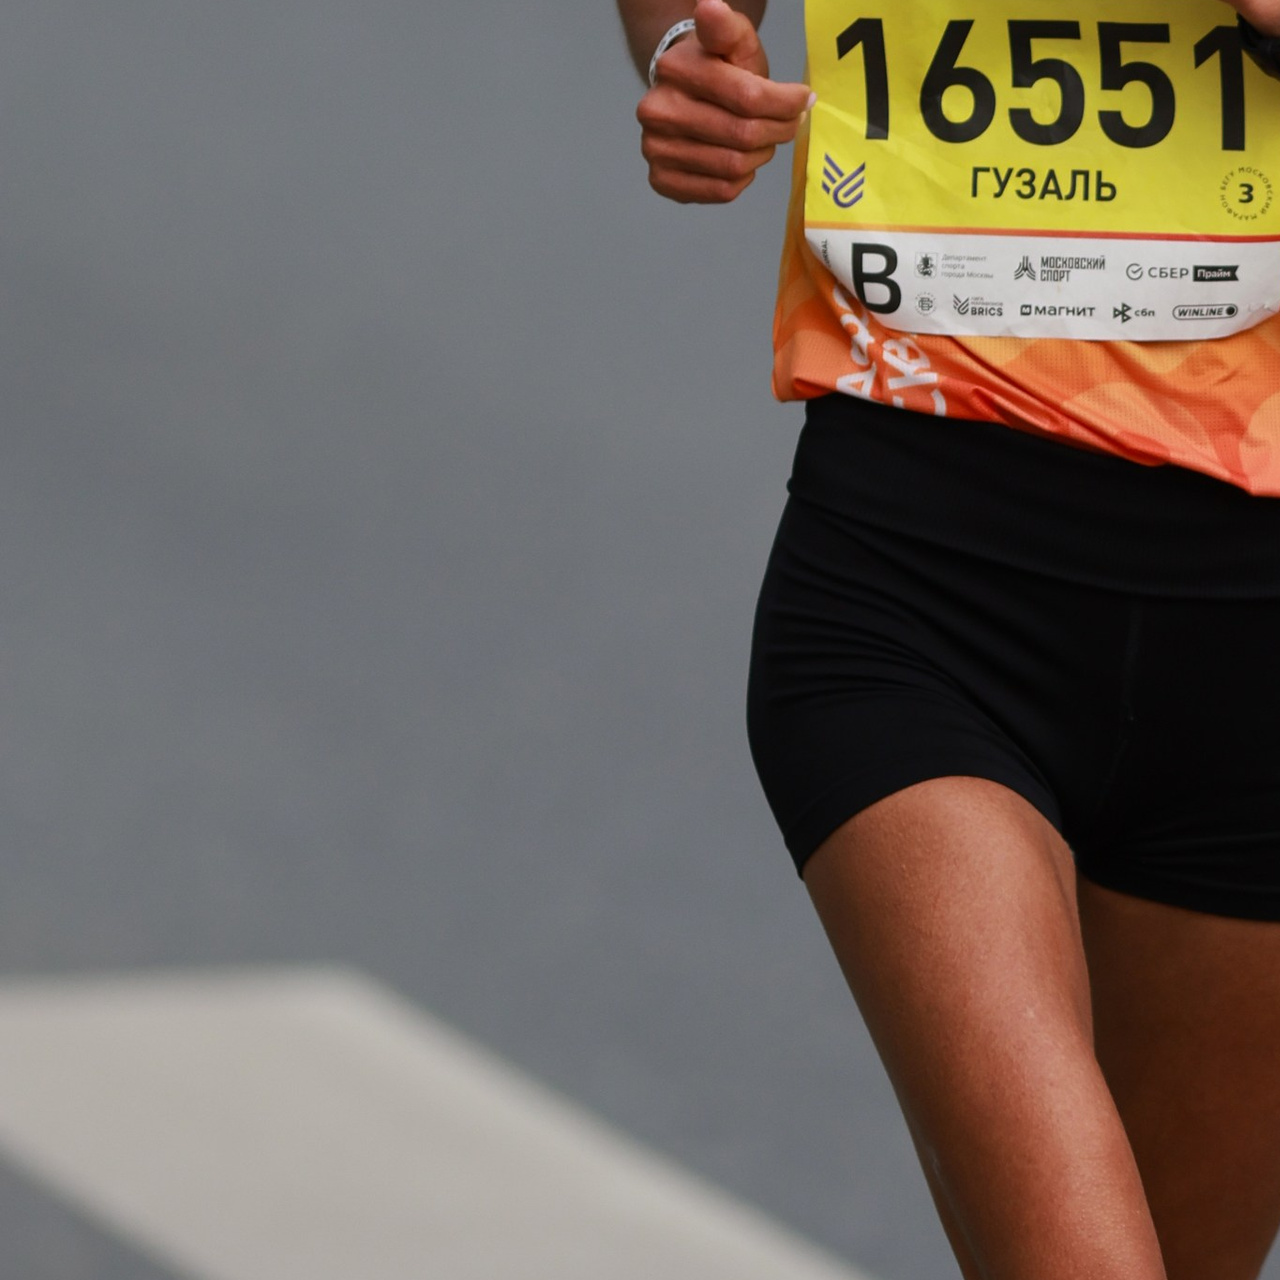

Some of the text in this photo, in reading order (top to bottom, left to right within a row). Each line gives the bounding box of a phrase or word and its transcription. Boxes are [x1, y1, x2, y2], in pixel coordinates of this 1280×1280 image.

[835, 17, 1246, 152] 16551
[970, 166, 1118, 202] ГУЗАЛЬ
[1238, 183, 1254, 204] 3
[1040, 255, 1106, 270] МОСКОВСКИЙ
[1040, 269, 1071, 282] СПОРТ
[1147, 267, 1231, 279] СБЕР Прайм
[971, 307, 1004, 317] BRICS
[1177, 307, 1224, 317] WINLINE
